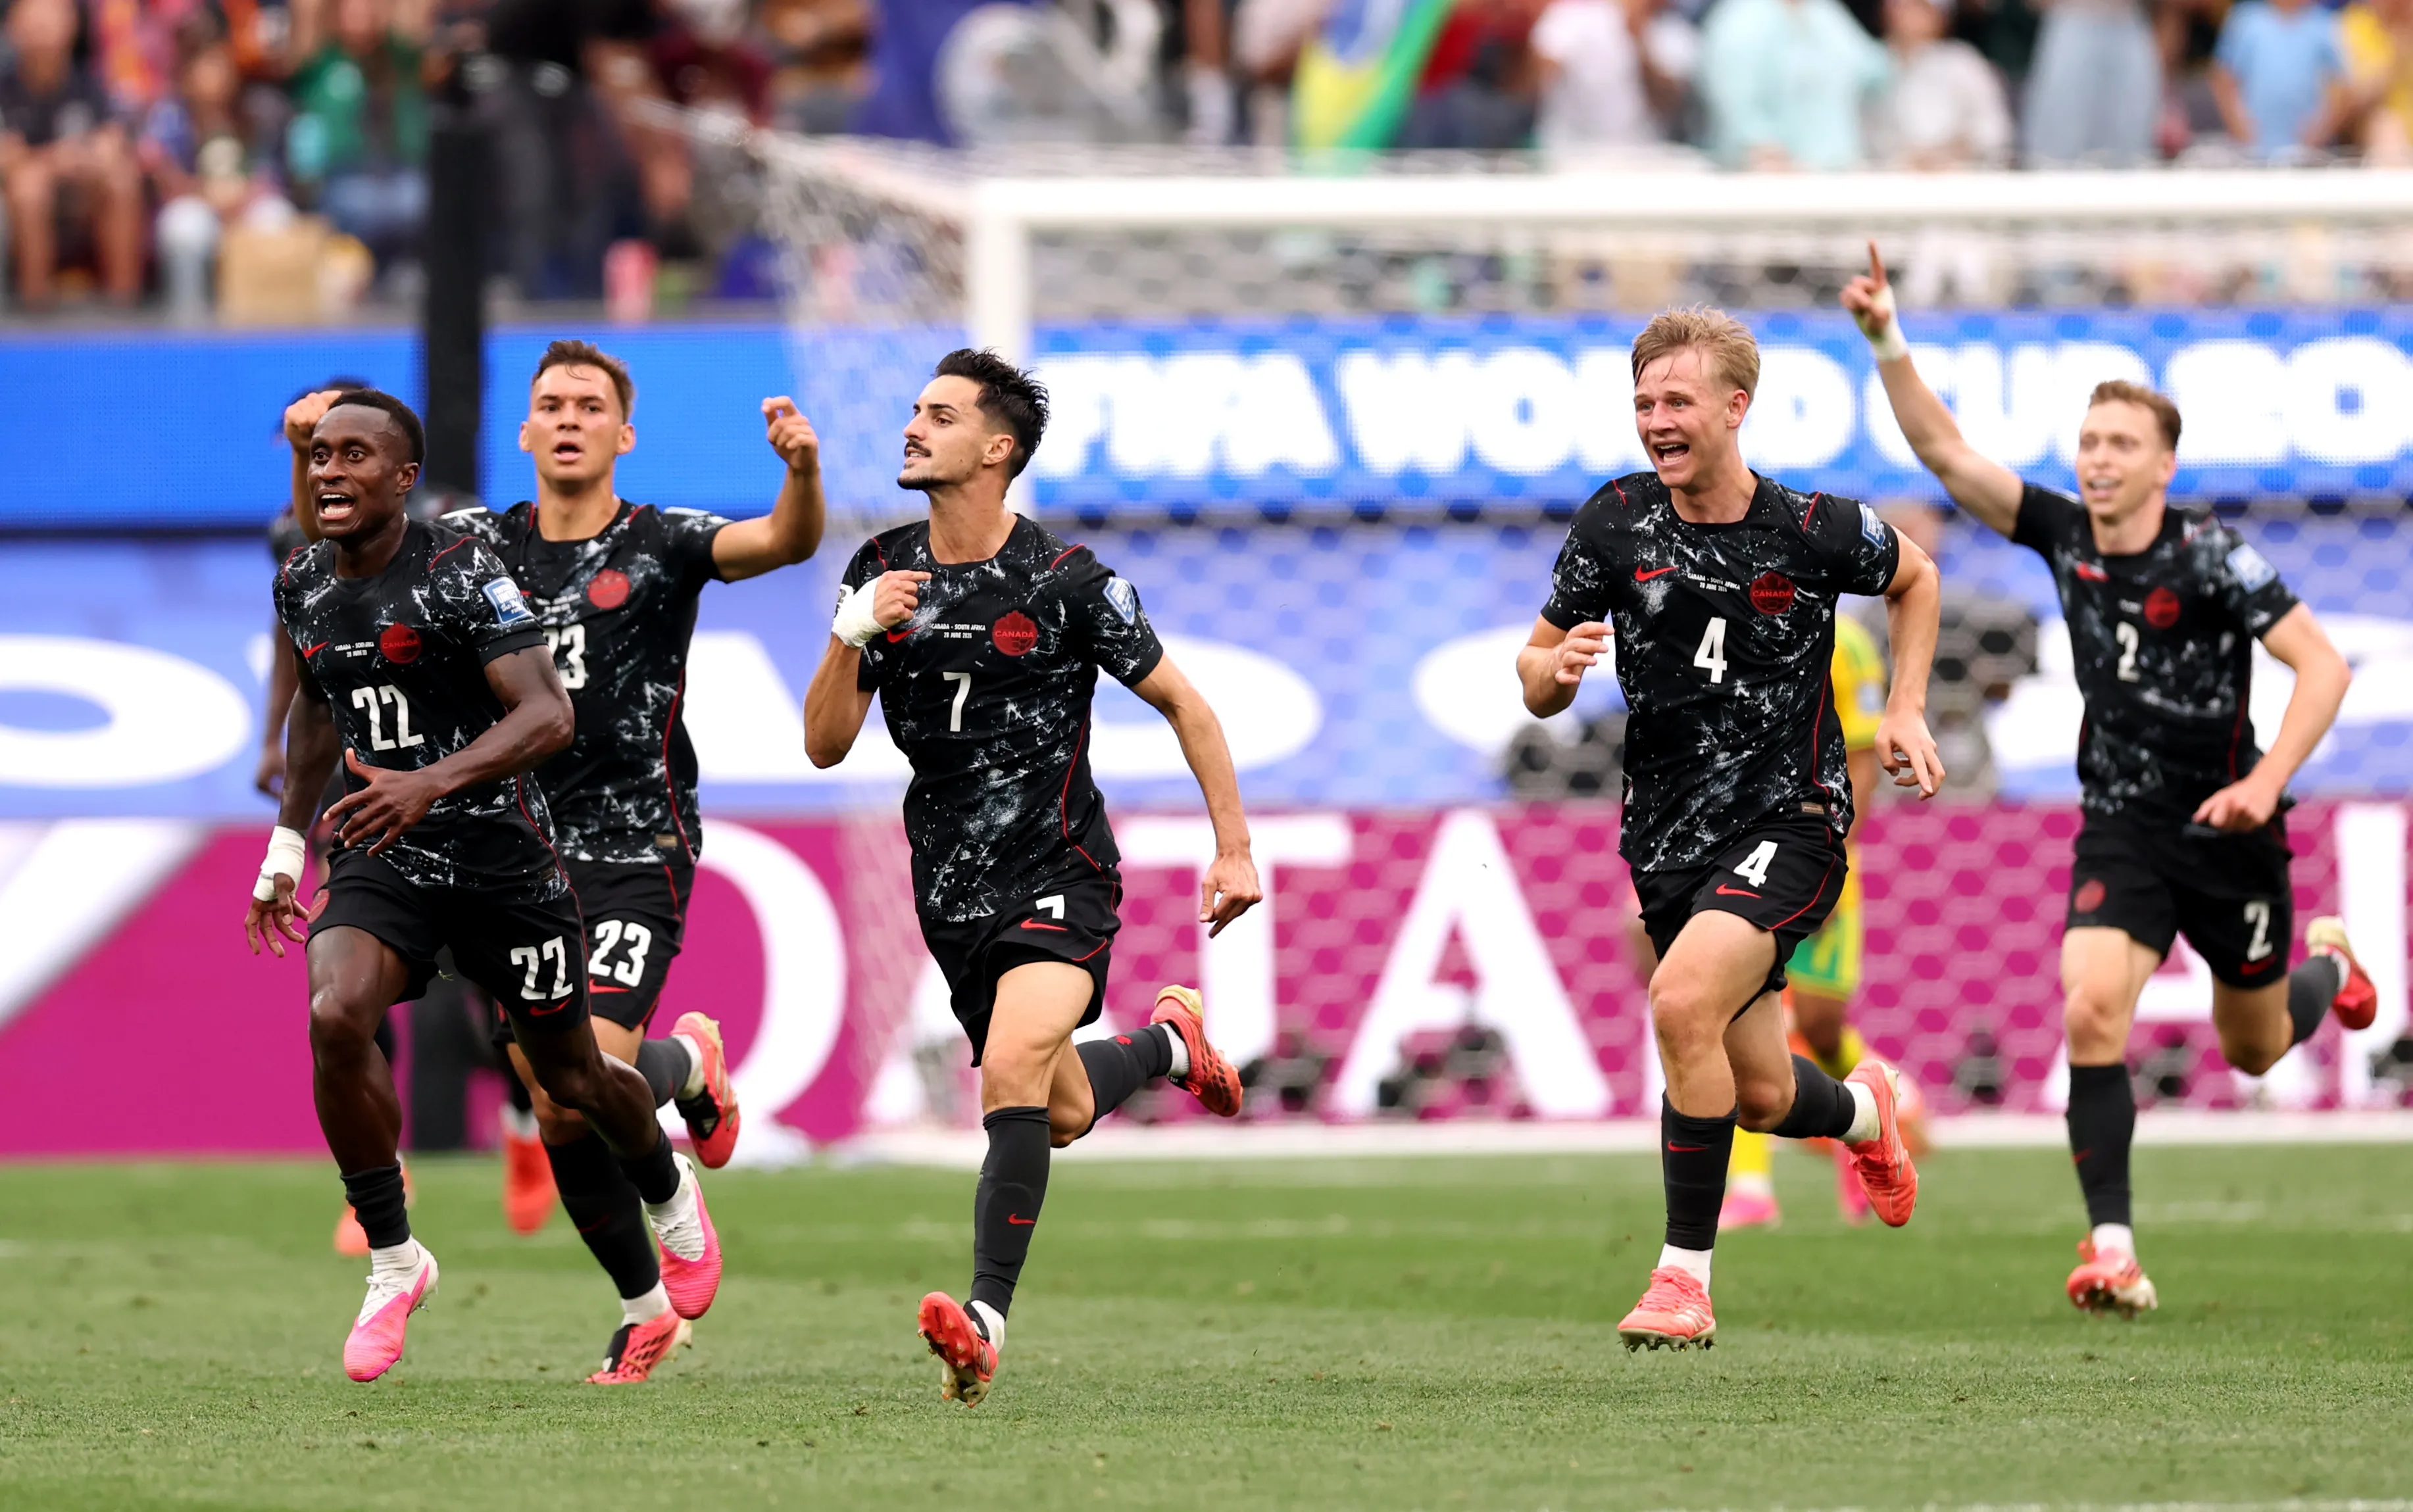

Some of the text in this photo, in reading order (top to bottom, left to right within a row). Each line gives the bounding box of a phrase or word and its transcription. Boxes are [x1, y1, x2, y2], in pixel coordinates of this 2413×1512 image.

[1035, 355, 1333, 471] FIFA
[1340, 349, 1853, 471] WORD
[1687, 573, 1706, 581] CANADA
[1724, 581, 1741, 590] AFRICA
[382, 639, 419, 649] CANADA
[1693, 617, 1728, 684] 4
[2116, 621, 2140, 682] 2
[351, 685, 424, 751] 22
[943, 671, 971, 732] 7
[1733, 841, 1778, 888] 4
[1035, 894, 1065, 919] 7
[2244, 900, 2273, 962] 2
[510, 935, 573, 1000] 22
[588, 919, 651, 987] 23
